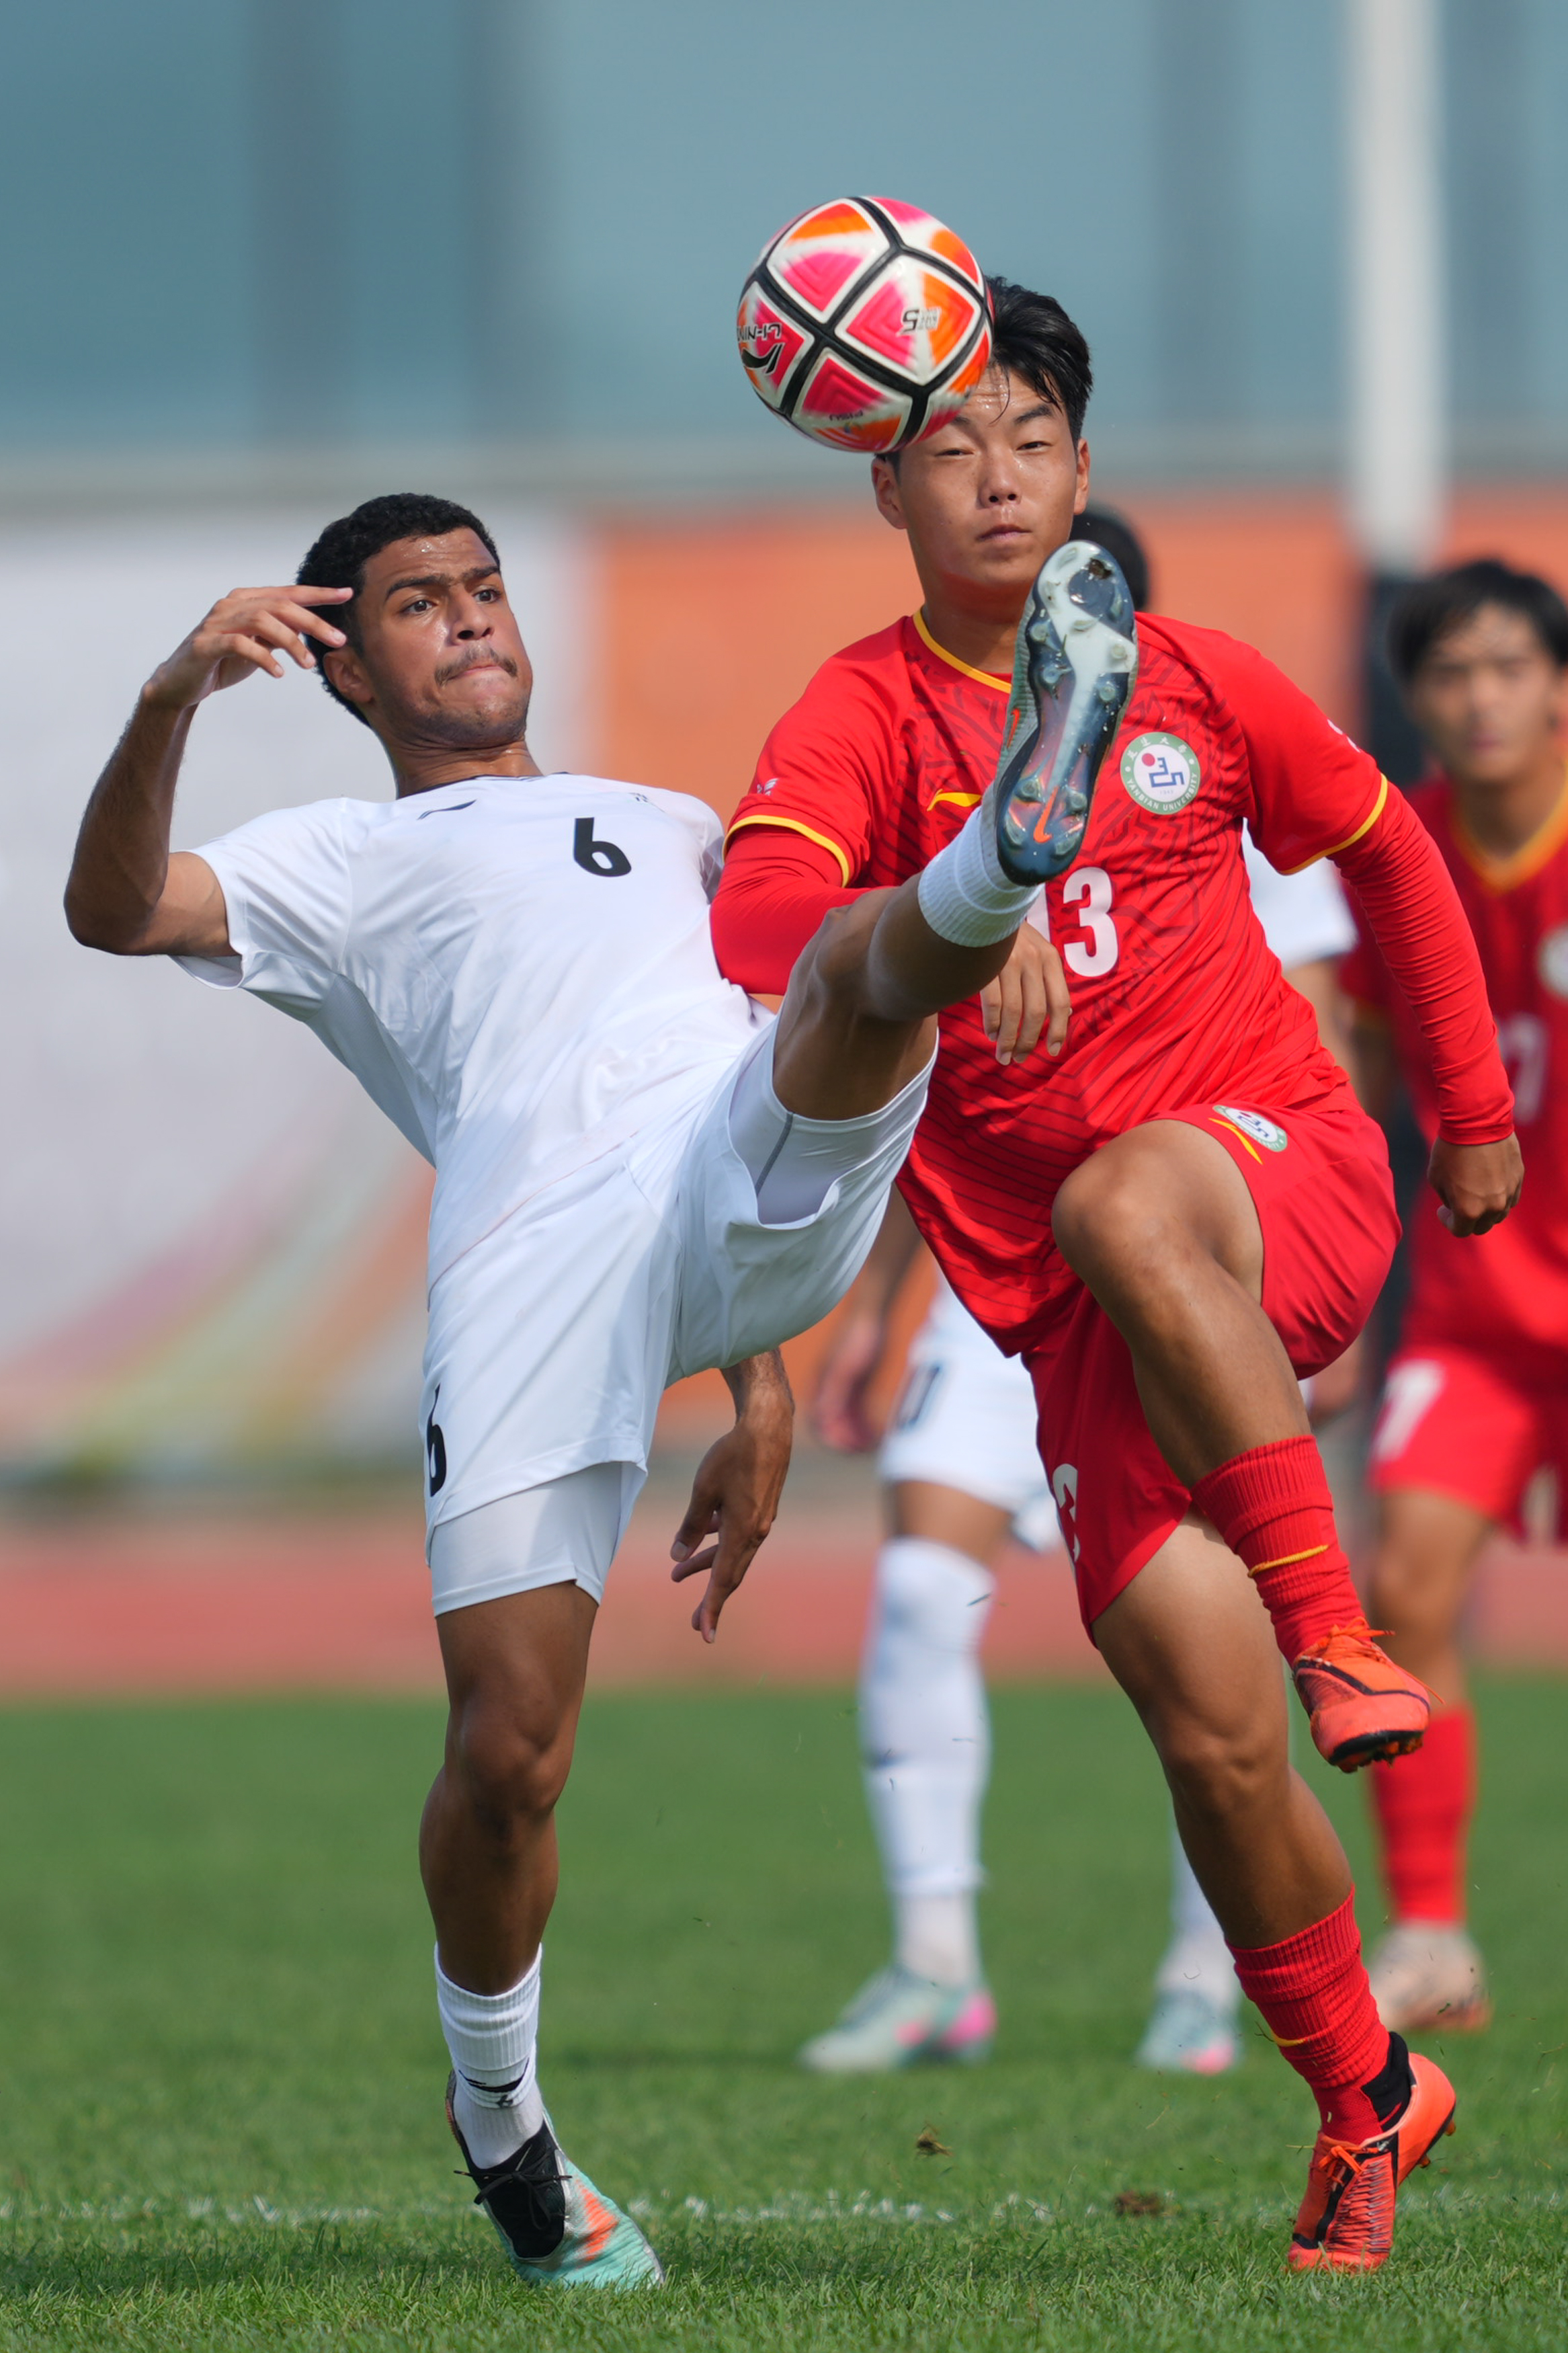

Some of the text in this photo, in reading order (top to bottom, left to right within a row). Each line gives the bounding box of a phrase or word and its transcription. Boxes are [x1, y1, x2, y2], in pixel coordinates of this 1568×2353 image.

[1127, 772, 1198, 811] YANBIAN UNIVERSITY
[573, 817, 632, 877] 6
